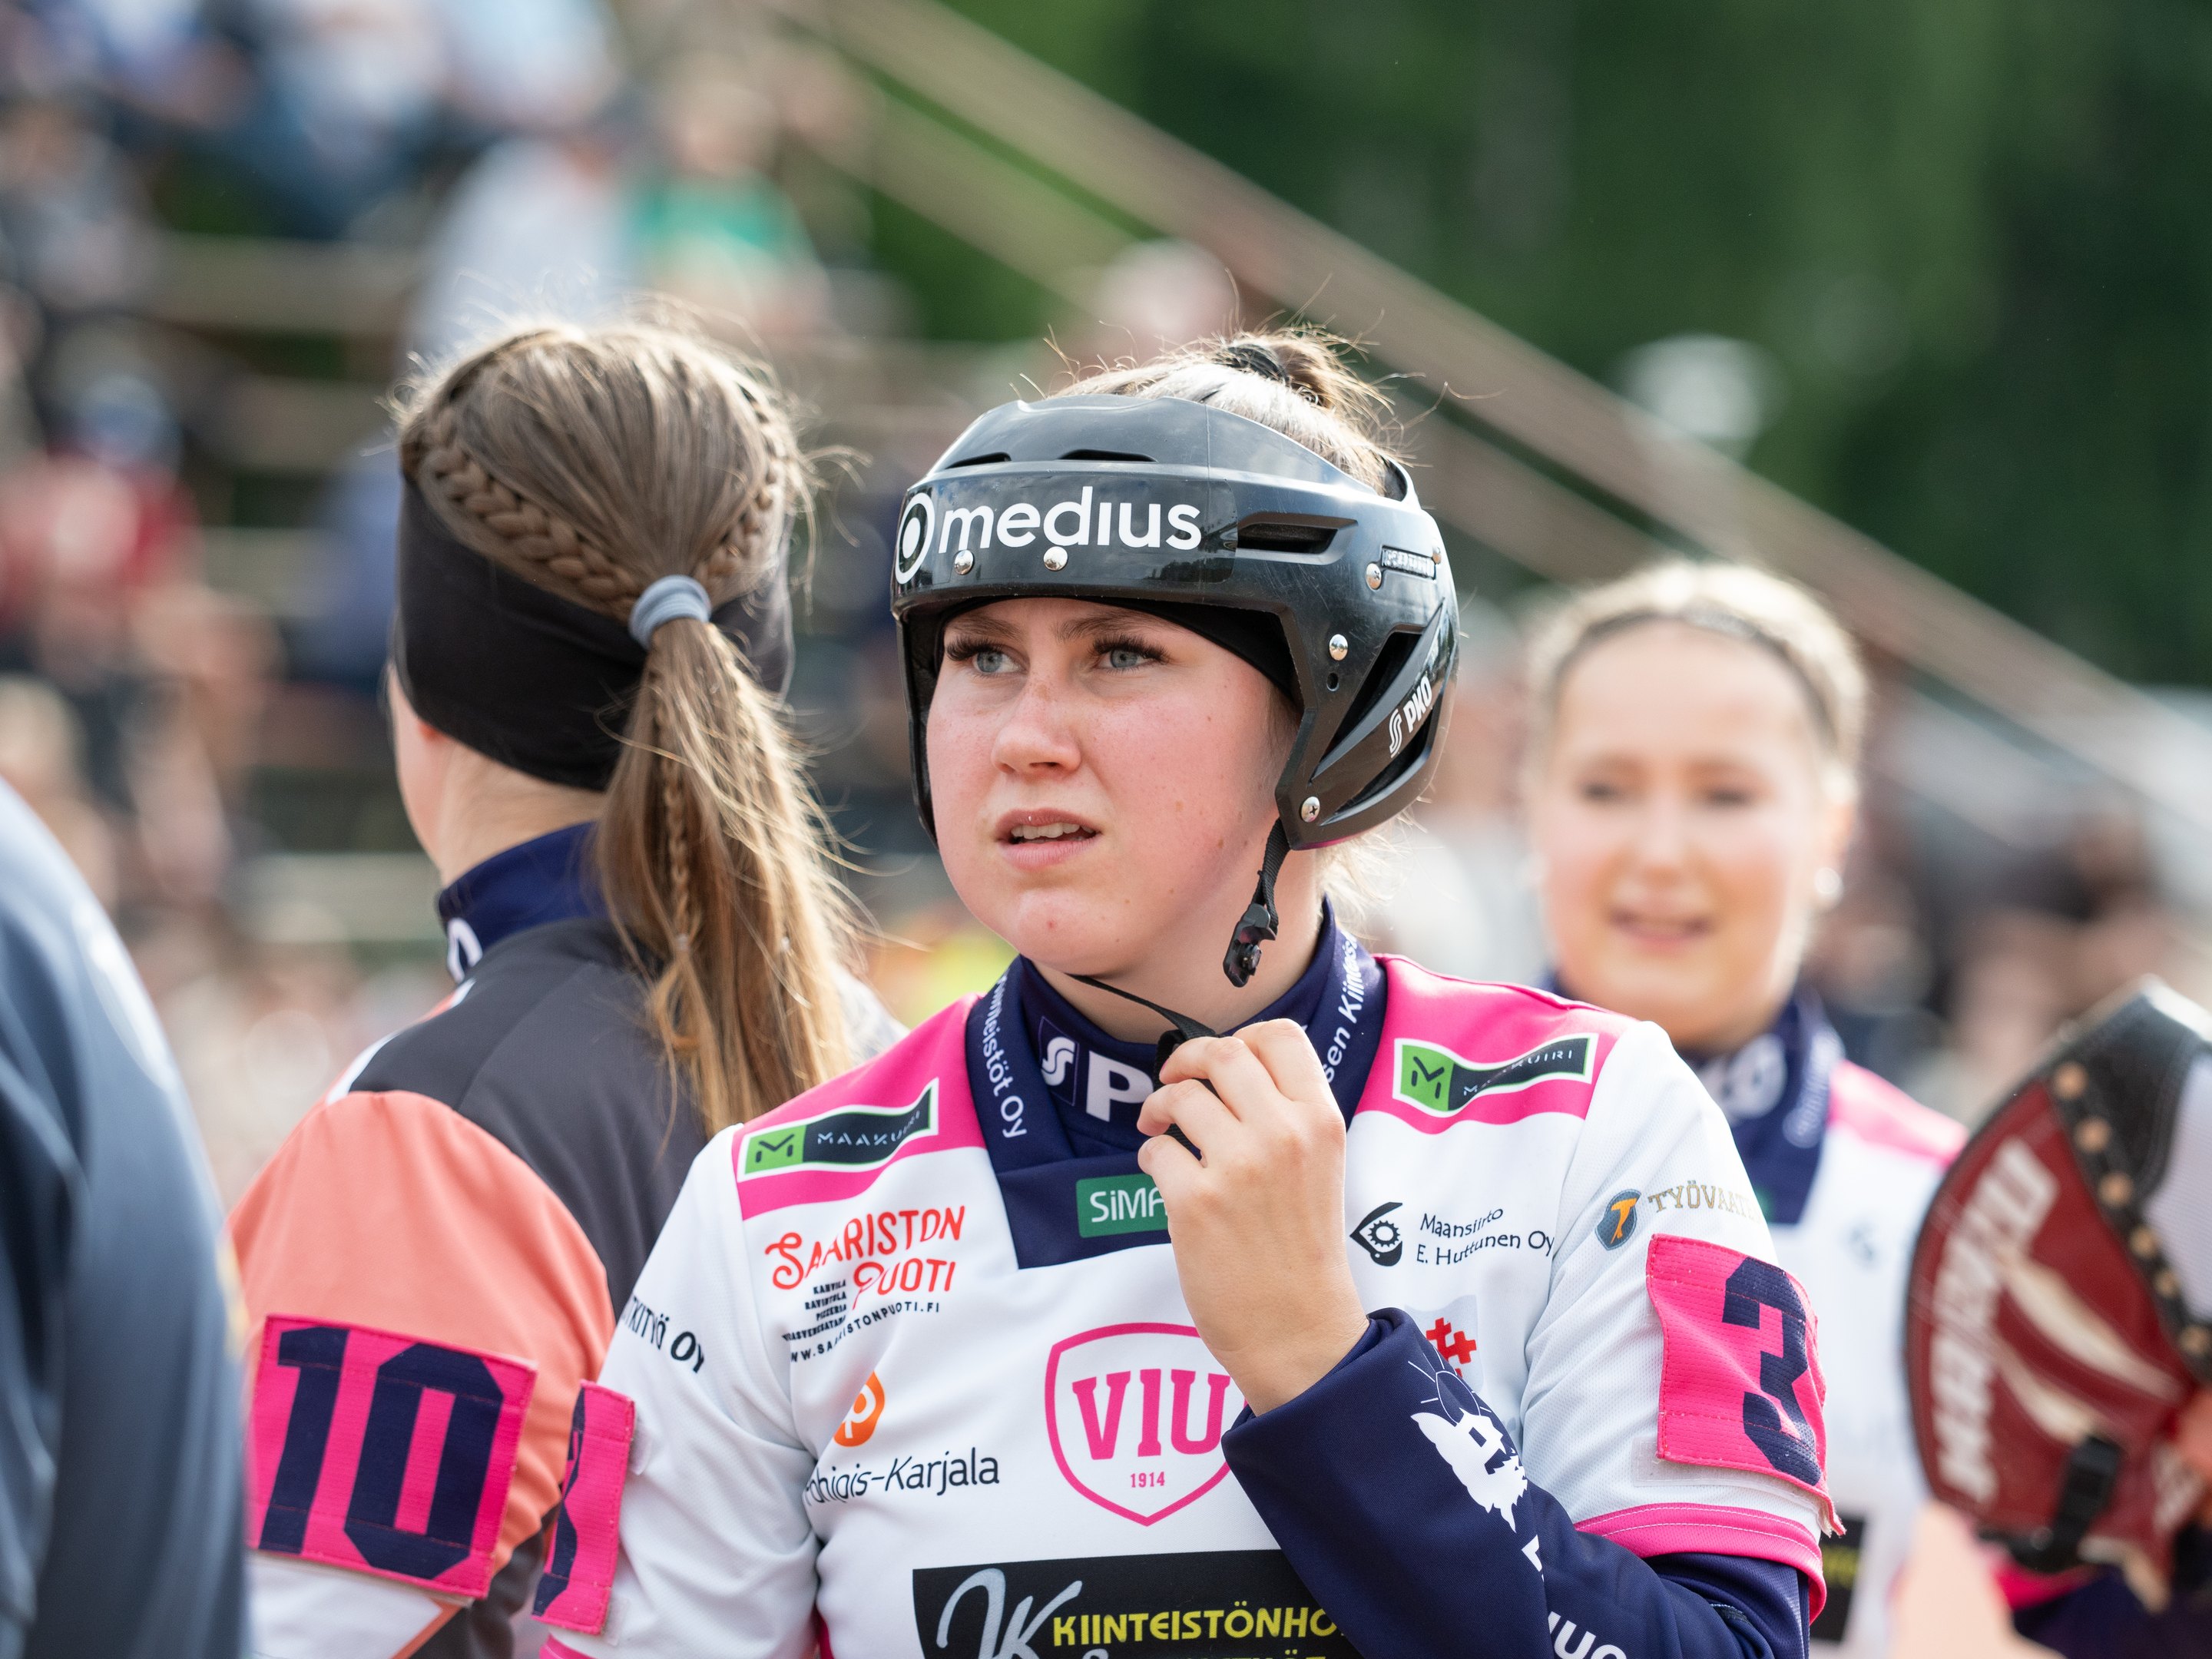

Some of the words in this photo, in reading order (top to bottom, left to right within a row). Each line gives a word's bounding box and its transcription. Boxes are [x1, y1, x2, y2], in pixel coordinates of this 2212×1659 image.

[939, 486, 1202, 554] medius
[1403, 675, 1432, 733] PKO
[1000, 1095, 1027, 1138] Oy
[764, 1205, 965, 1290] SAARISTON
[1416, 1243, 1428, 1264] E.
[1435, 1233, 1521, 1266] Huttunen
[1528, 1230, 1555, 1257] Oy
[1420, 1208, 1503, 1239] Maansiirto
[852, 1258, 956, 1310] PUOTI
[670, 1331, 704, 1373] OY
[1072, 1368, 1230, 1460] VIU
[259, 1326, 505, 1581] 10
[804, 1446, 1000, 1506] ohjois-Karjala
[1130, 1471, 1165, 1488] 1914
[1053, 1601, 1344, 1647] KIINTEISTÖNHO
